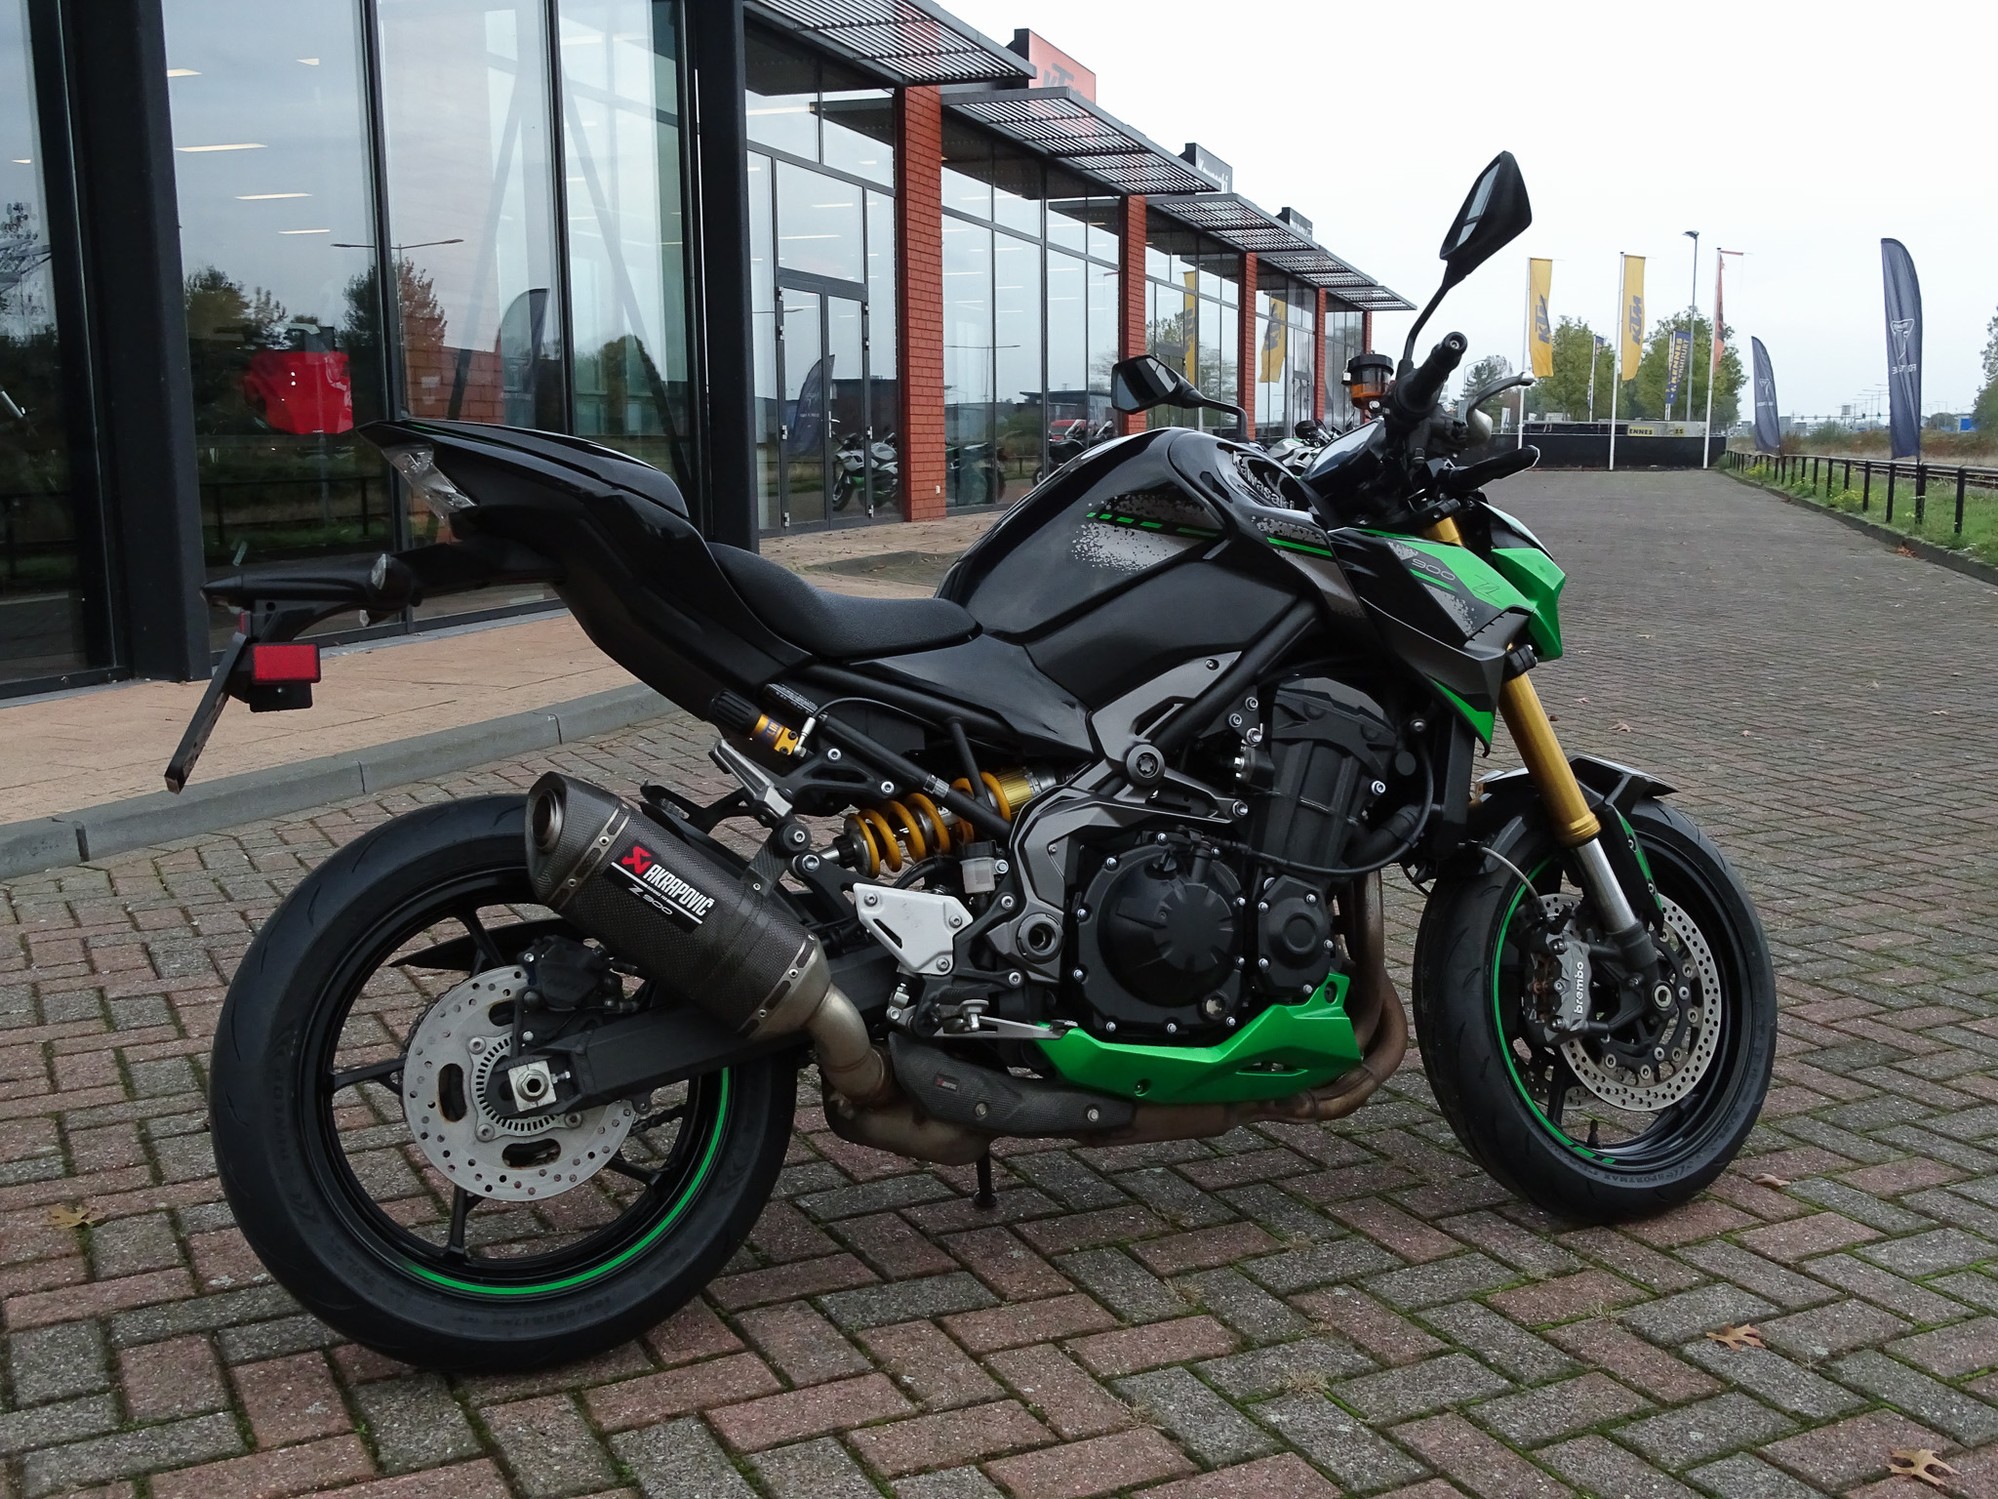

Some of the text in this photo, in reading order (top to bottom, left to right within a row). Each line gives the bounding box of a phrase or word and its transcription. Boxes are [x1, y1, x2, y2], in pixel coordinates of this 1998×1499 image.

[1629, 295, 1642, 345] KTM
[1411, 558, 1456, 581] 900
[1573, 961, 1584, 1014] brembo
